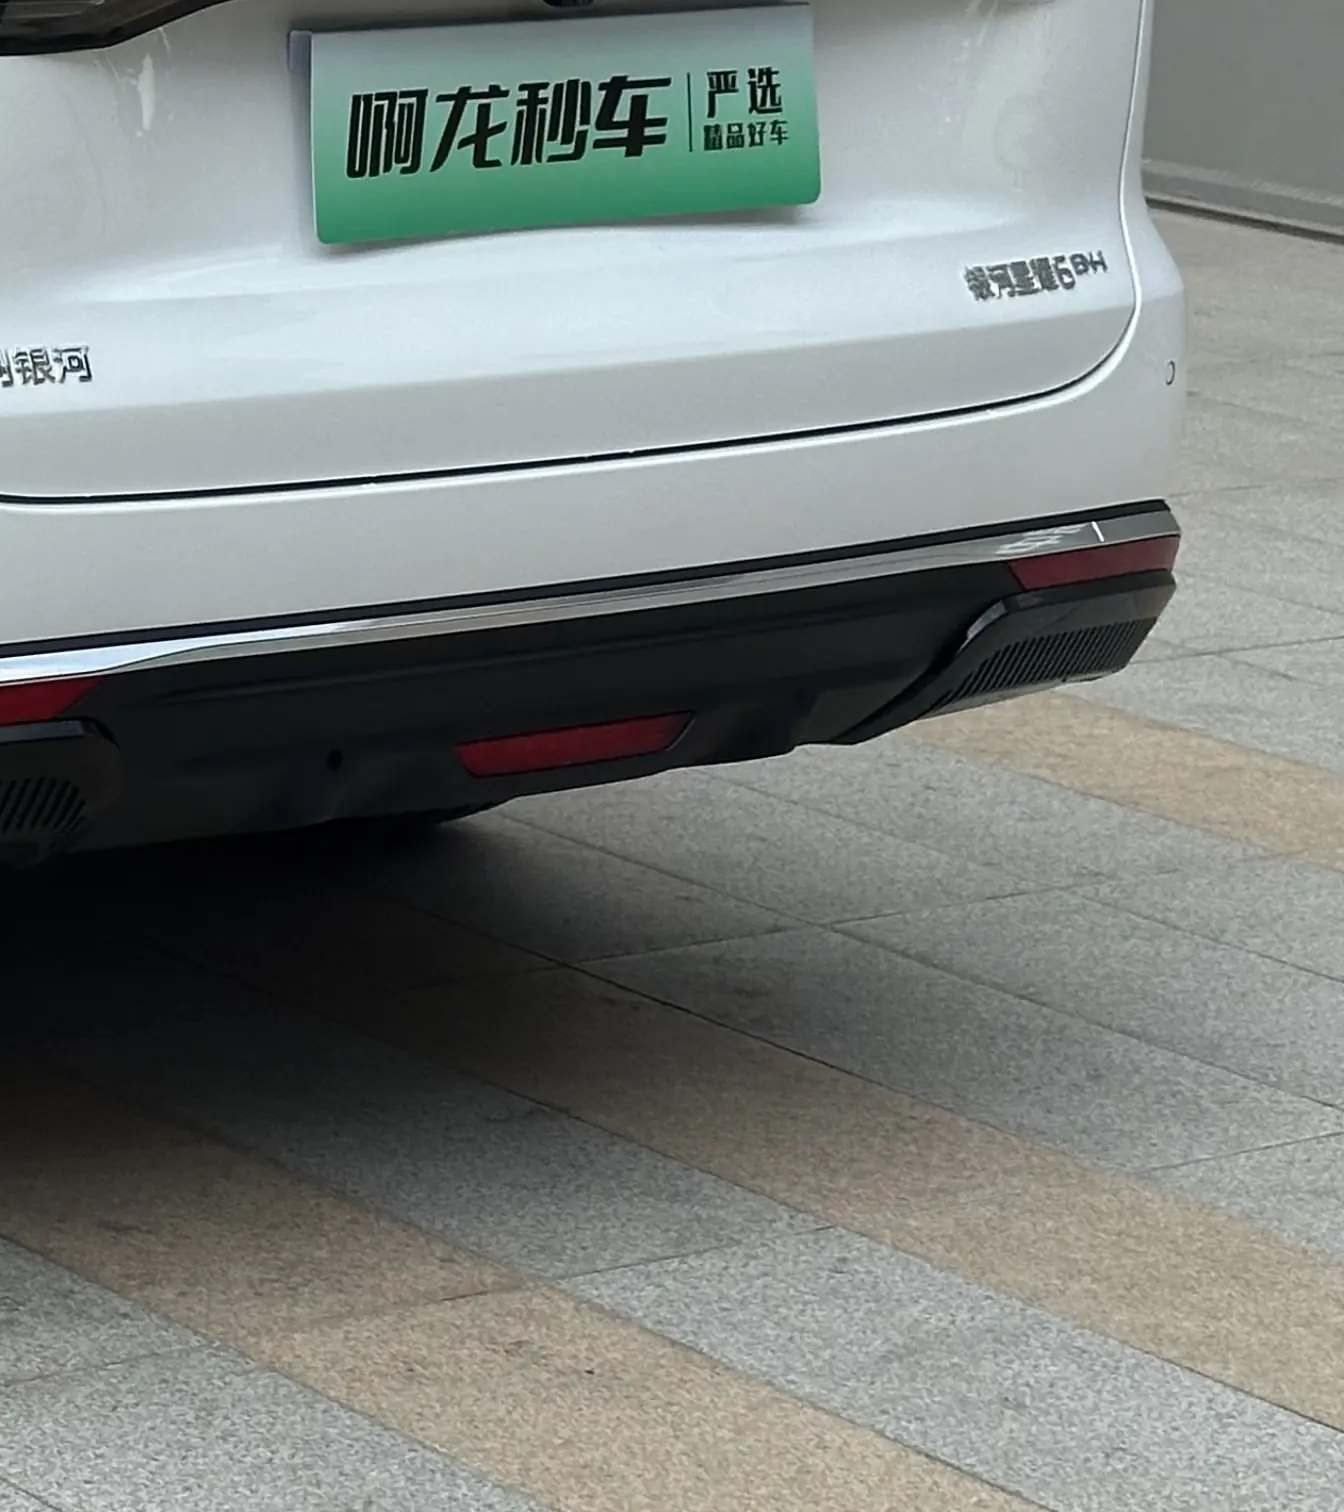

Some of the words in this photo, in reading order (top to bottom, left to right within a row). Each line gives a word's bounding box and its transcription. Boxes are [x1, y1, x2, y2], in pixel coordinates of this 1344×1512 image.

[346, 74, 672, 178] 啊龙秒车
[706, 66, 783, 119] 严选
